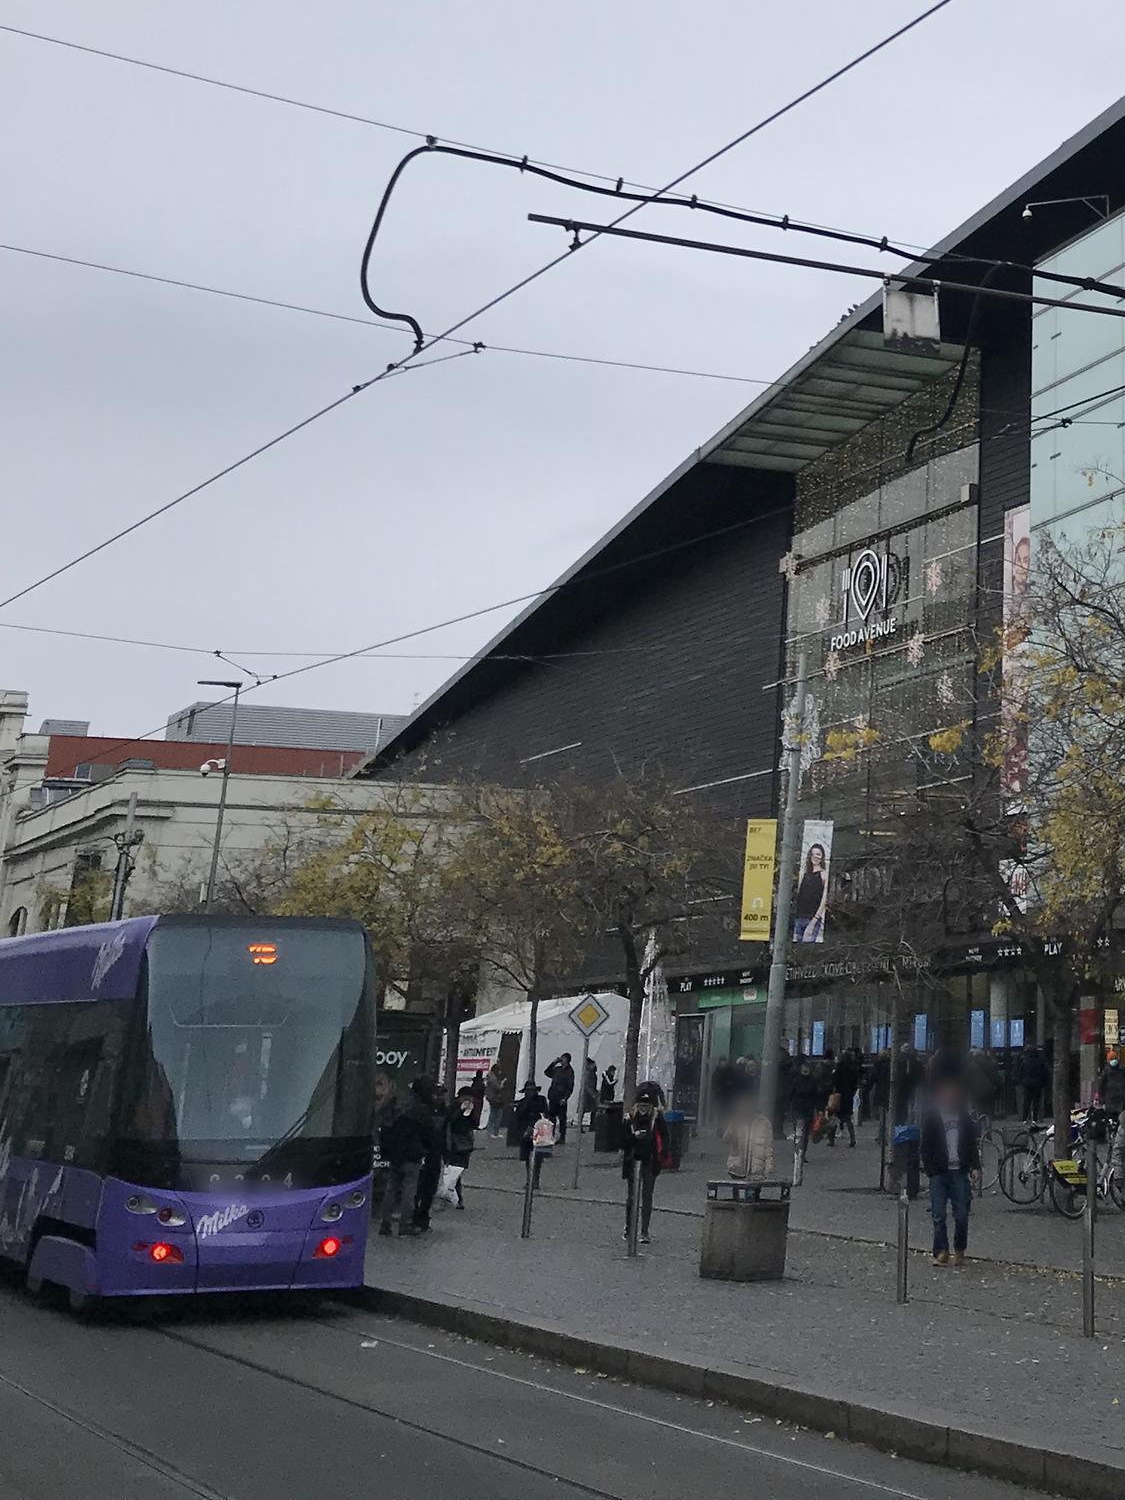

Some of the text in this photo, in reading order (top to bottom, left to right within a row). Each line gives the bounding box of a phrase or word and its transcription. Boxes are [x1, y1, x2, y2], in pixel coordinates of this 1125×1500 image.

[831, 617, 897, 651] FOOD AVENUE
[743, 913, 759, 922] 400
[1044, 941, 1063, 956] PLAY
[196, 1203, 250, 1240] Milka
